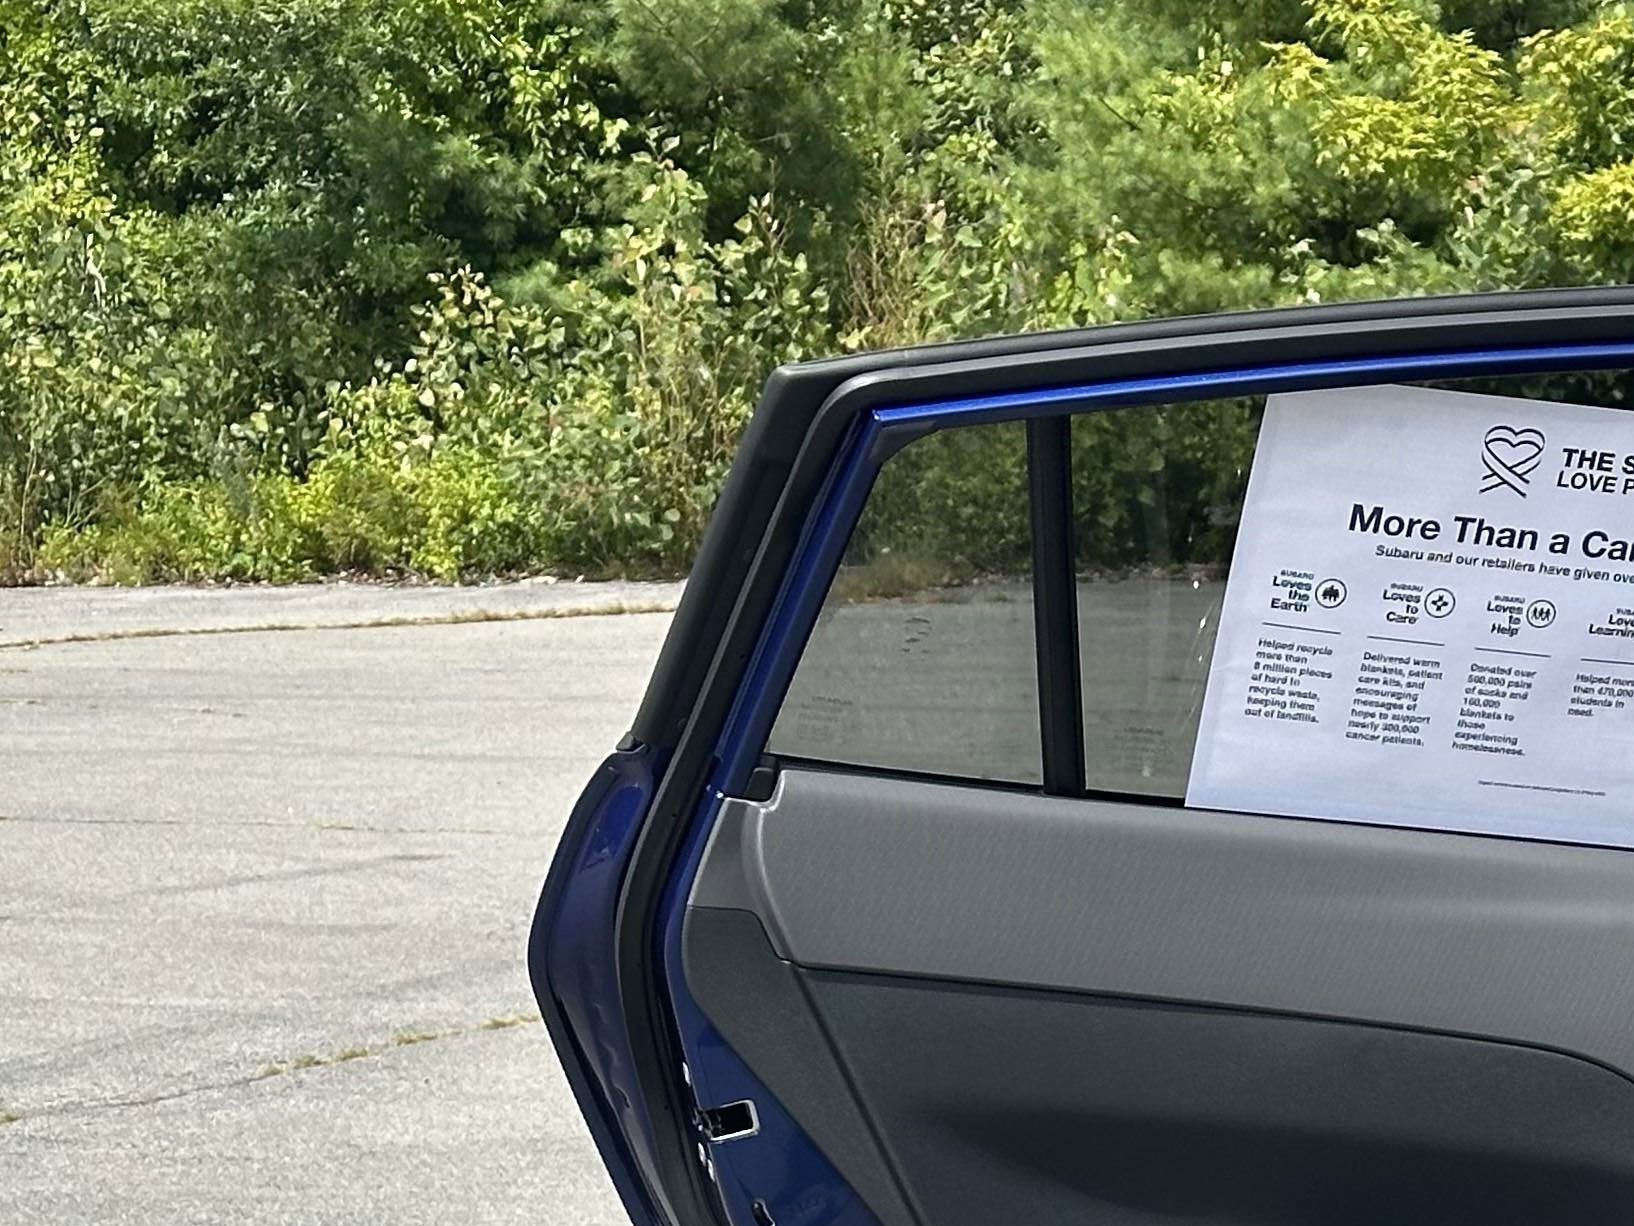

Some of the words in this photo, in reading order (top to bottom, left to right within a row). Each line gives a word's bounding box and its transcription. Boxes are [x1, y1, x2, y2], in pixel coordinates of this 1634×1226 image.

[1562, 447, 1615, 472] THE
[1556, 470, 1618, 493] LOVE
[1348, 503, 1440, 540] More
[1454, 515, 1537, 550] Than
[1548, 533, 1569, 554] a
[1375, 544, 1423, 560] Subaru
[1426, 552, 1453, 563] and
[1455, 555, 1479, 566] our
[1481, 557, 1535, 572] retailers
[1538, 562, 1570, 576] have
[1573, 567, 1609, 580] given
[1272, 575, 1312, 591] Loves
[1288, 589, 1309, 601] the
[1382, 589, 1420, 603] Loves
[1270, 597, 1307, 612] Earth
[1405, 604, 1418, 614] to
[1486, 600, 1523, 614] Loves
[1386, 611, 1417, 624] Care
[1508, 614, 1521, 624] to
[1490, 623, 1519, 637] Help
